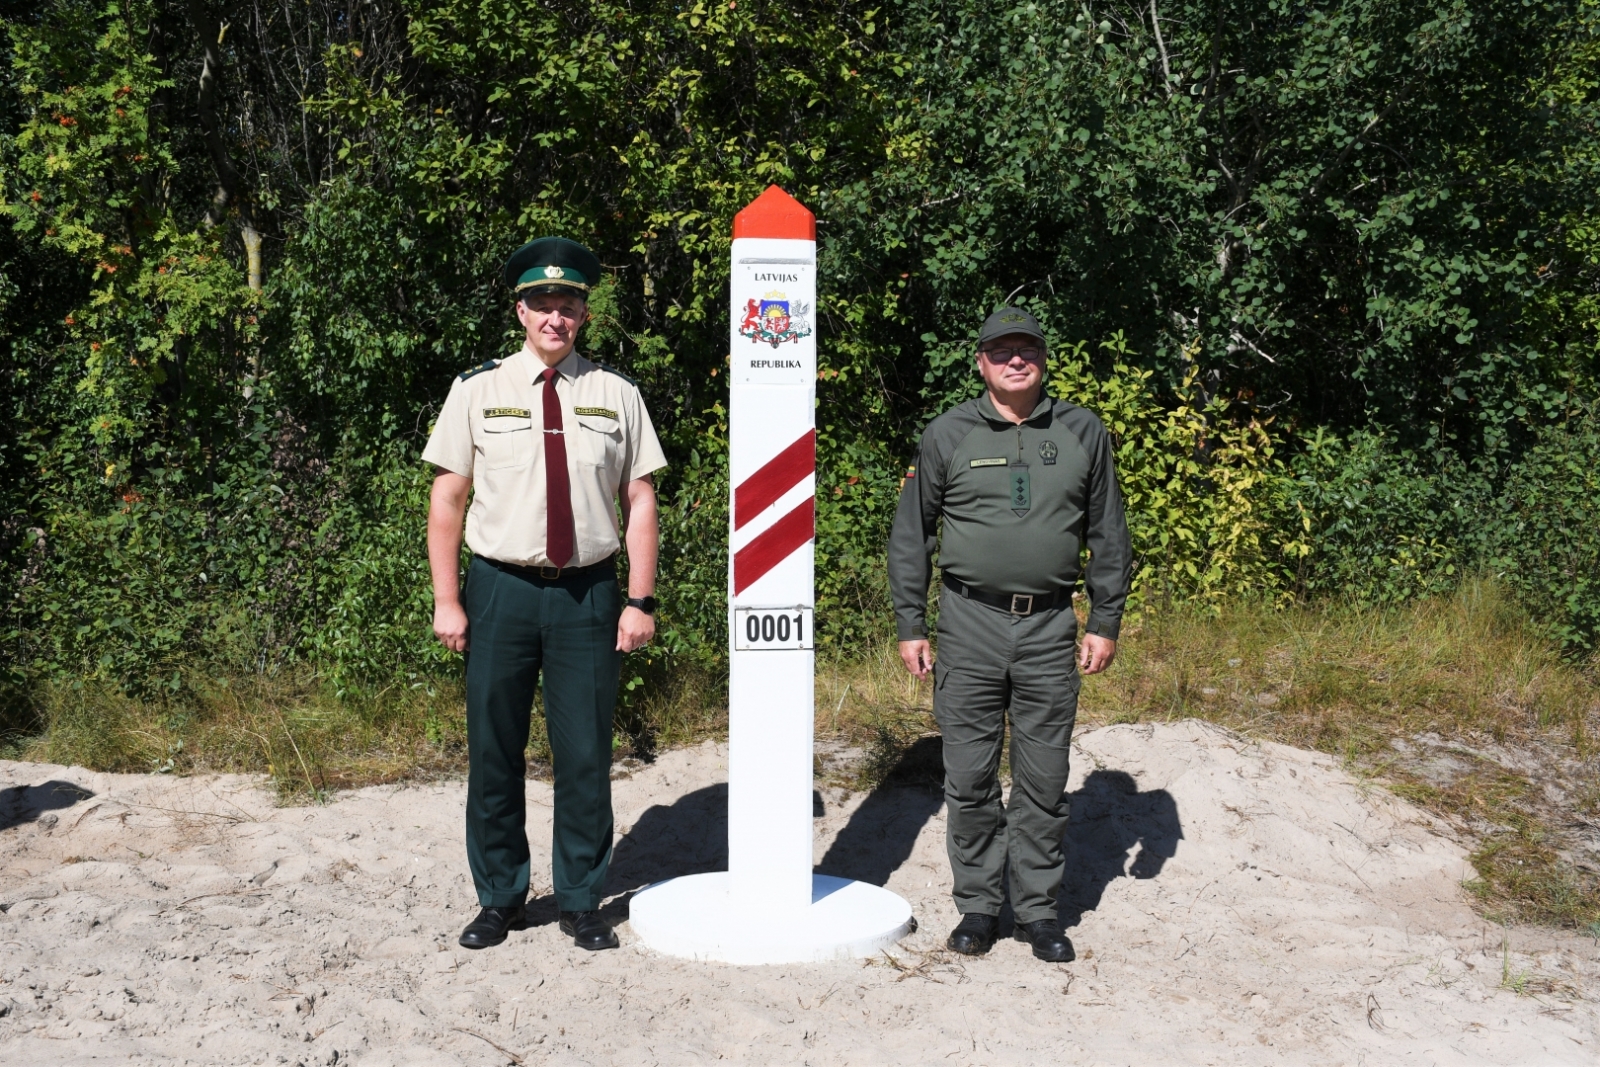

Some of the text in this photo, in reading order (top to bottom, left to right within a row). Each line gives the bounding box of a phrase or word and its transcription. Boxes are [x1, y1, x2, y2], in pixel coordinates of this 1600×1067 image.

[754, 273, 798, 283] LATVIJAS
[750, 360, 802, 369] REPUBLIKA
[746, 614, 803, 642] 0001
